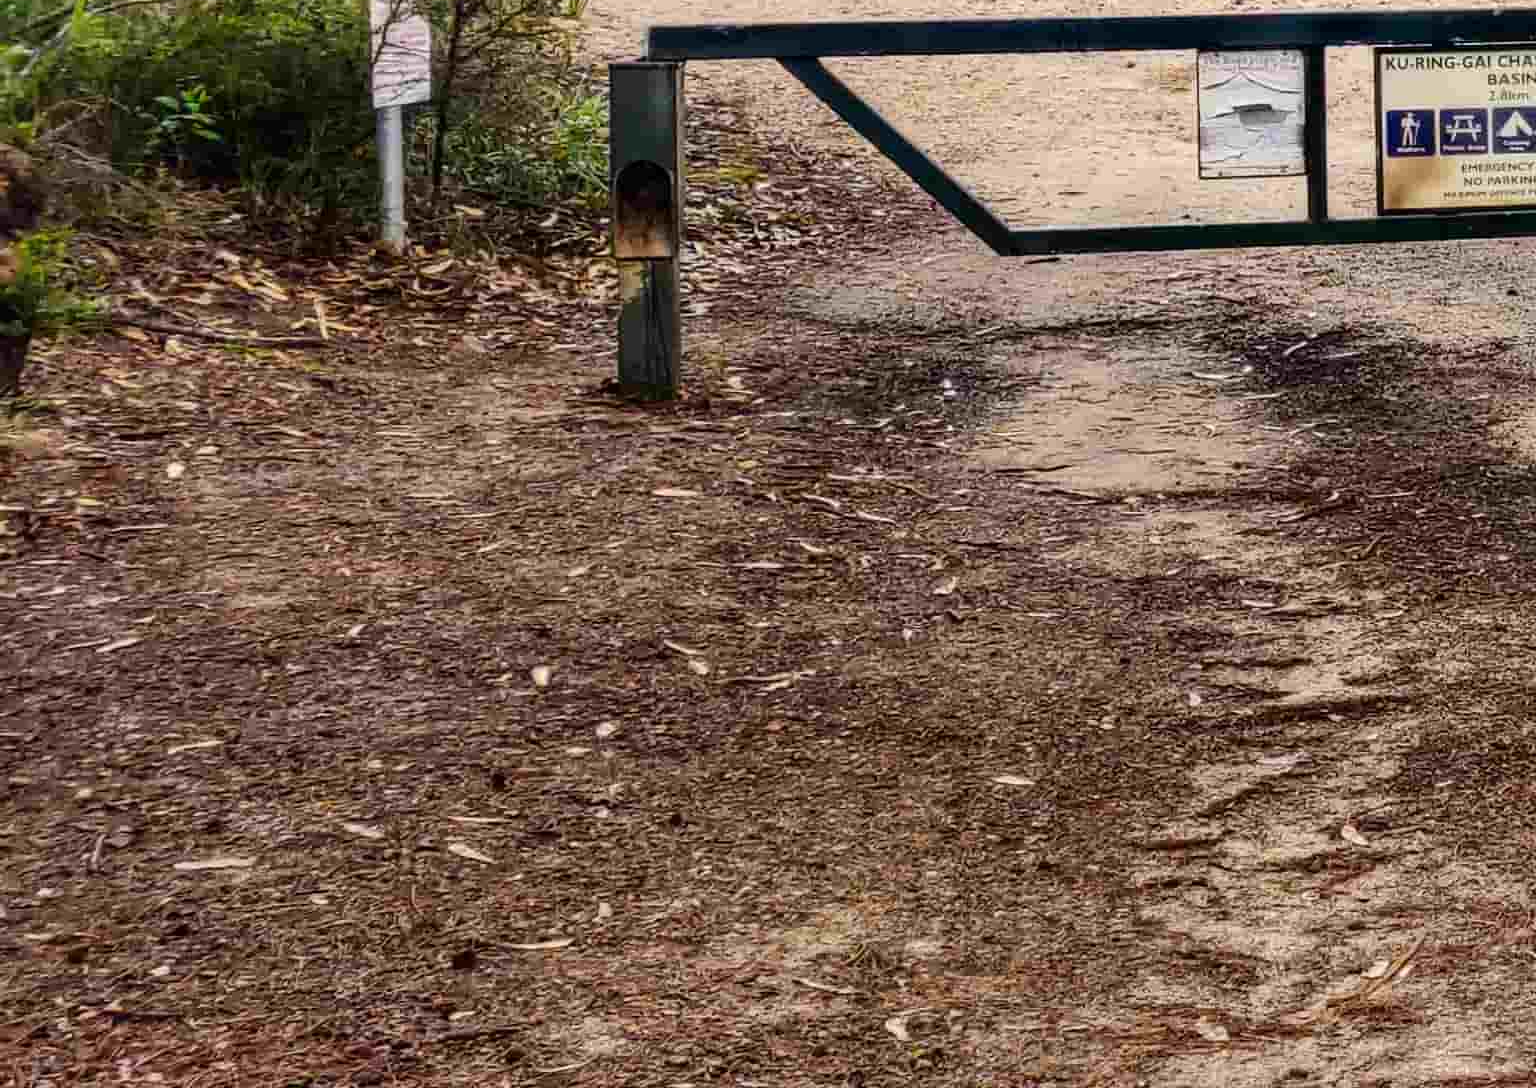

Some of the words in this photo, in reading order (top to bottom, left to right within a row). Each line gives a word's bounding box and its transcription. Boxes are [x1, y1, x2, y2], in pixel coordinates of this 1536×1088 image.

[1385, 54, 1492, 71] KU-RING-GAI
[1461, 161, 1533, 174] EMERGENCY
[1464, 176, 1483, 187] NO
